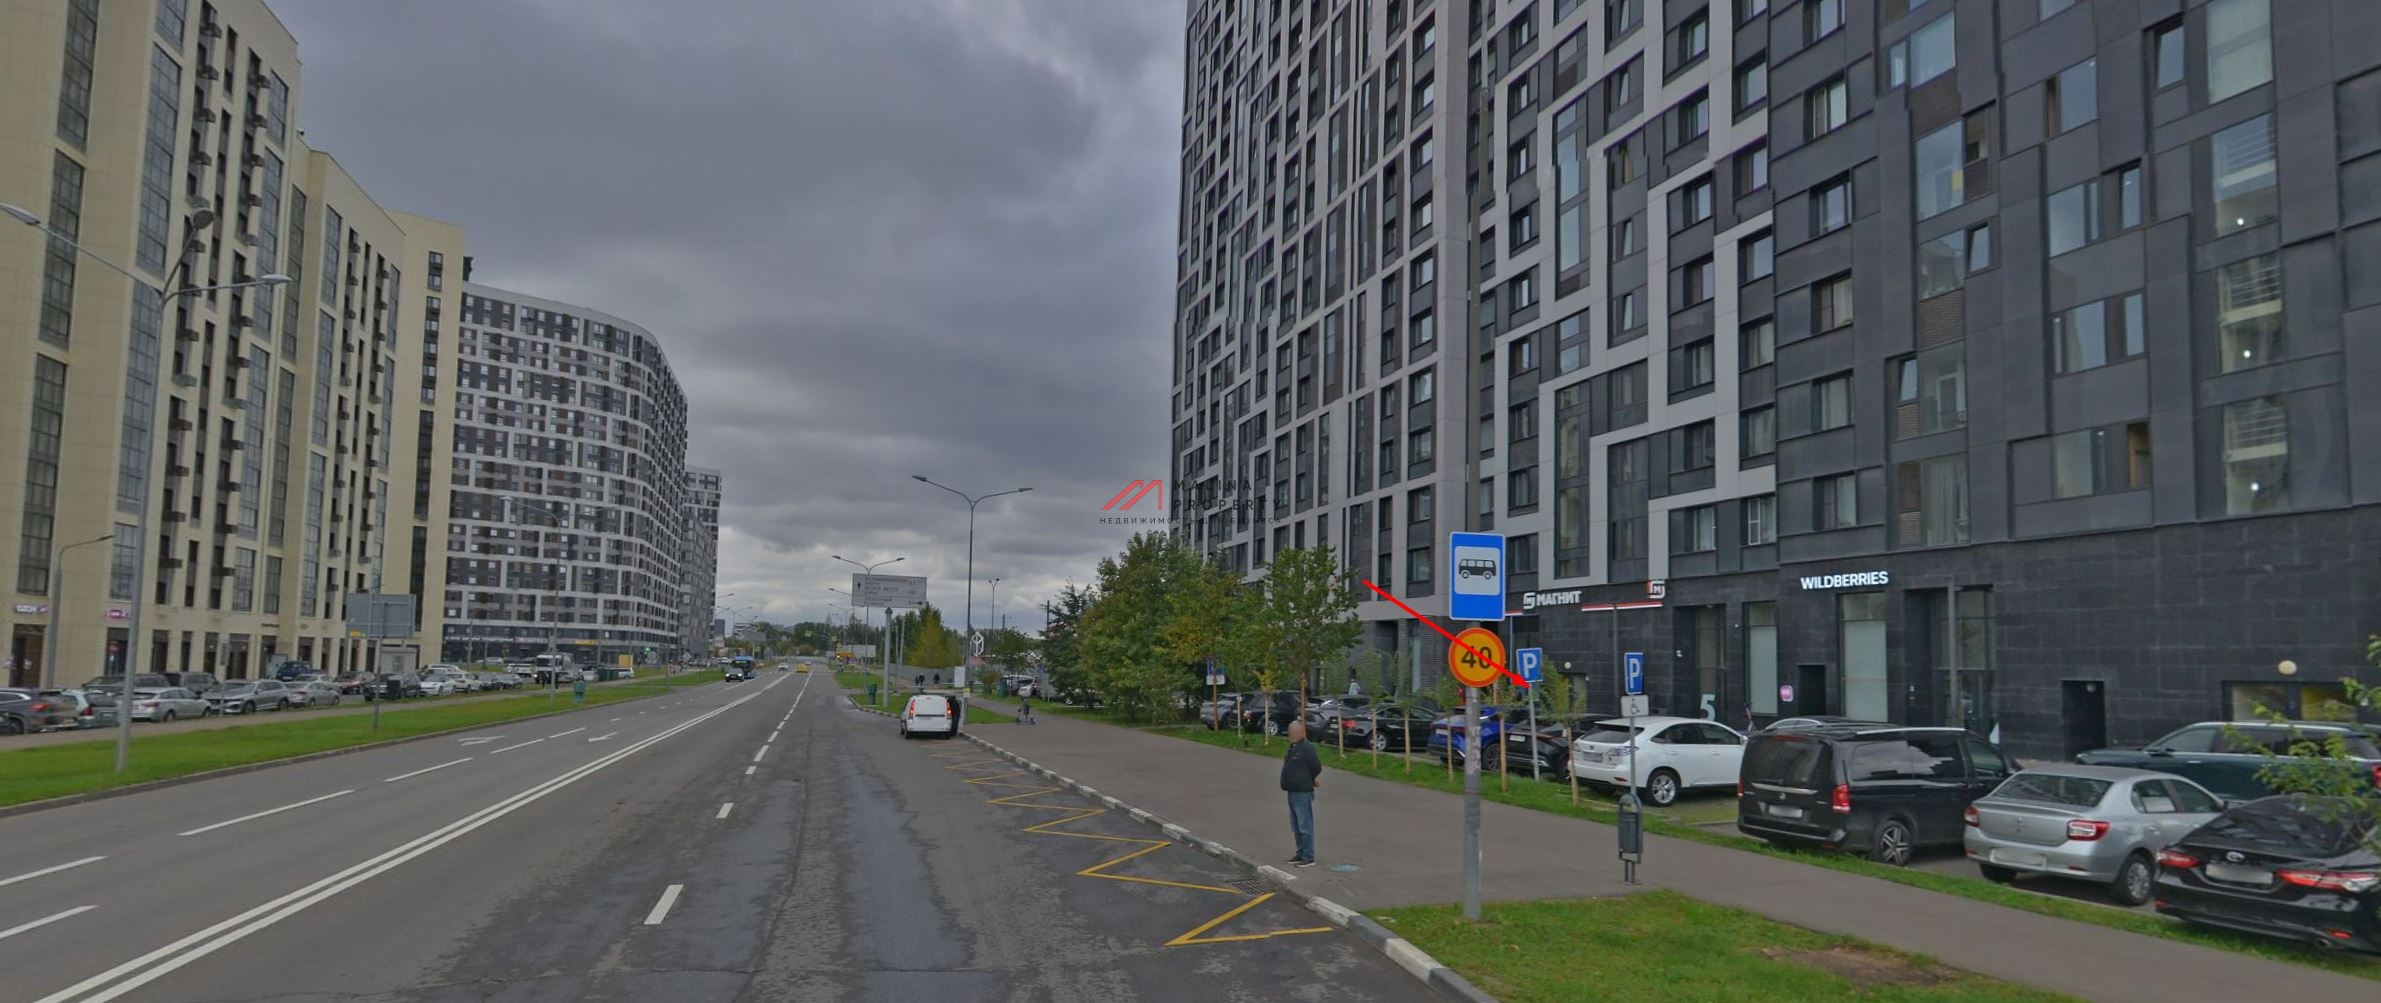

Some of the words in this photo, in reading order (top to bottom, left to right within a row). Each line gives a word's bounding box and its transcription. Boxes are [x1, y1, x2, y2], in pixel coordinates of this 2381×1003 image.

[1800, 571, 1889, 590] WILDBERRIES
[1536, 590, 1582, 606] МАГНИТ
[1461, 646, 1492, 669] 40
[1523, 652, 1537, 678] P
[1629, 658, 1641, 688] P
[1699, 693, 1716, 722] 5
